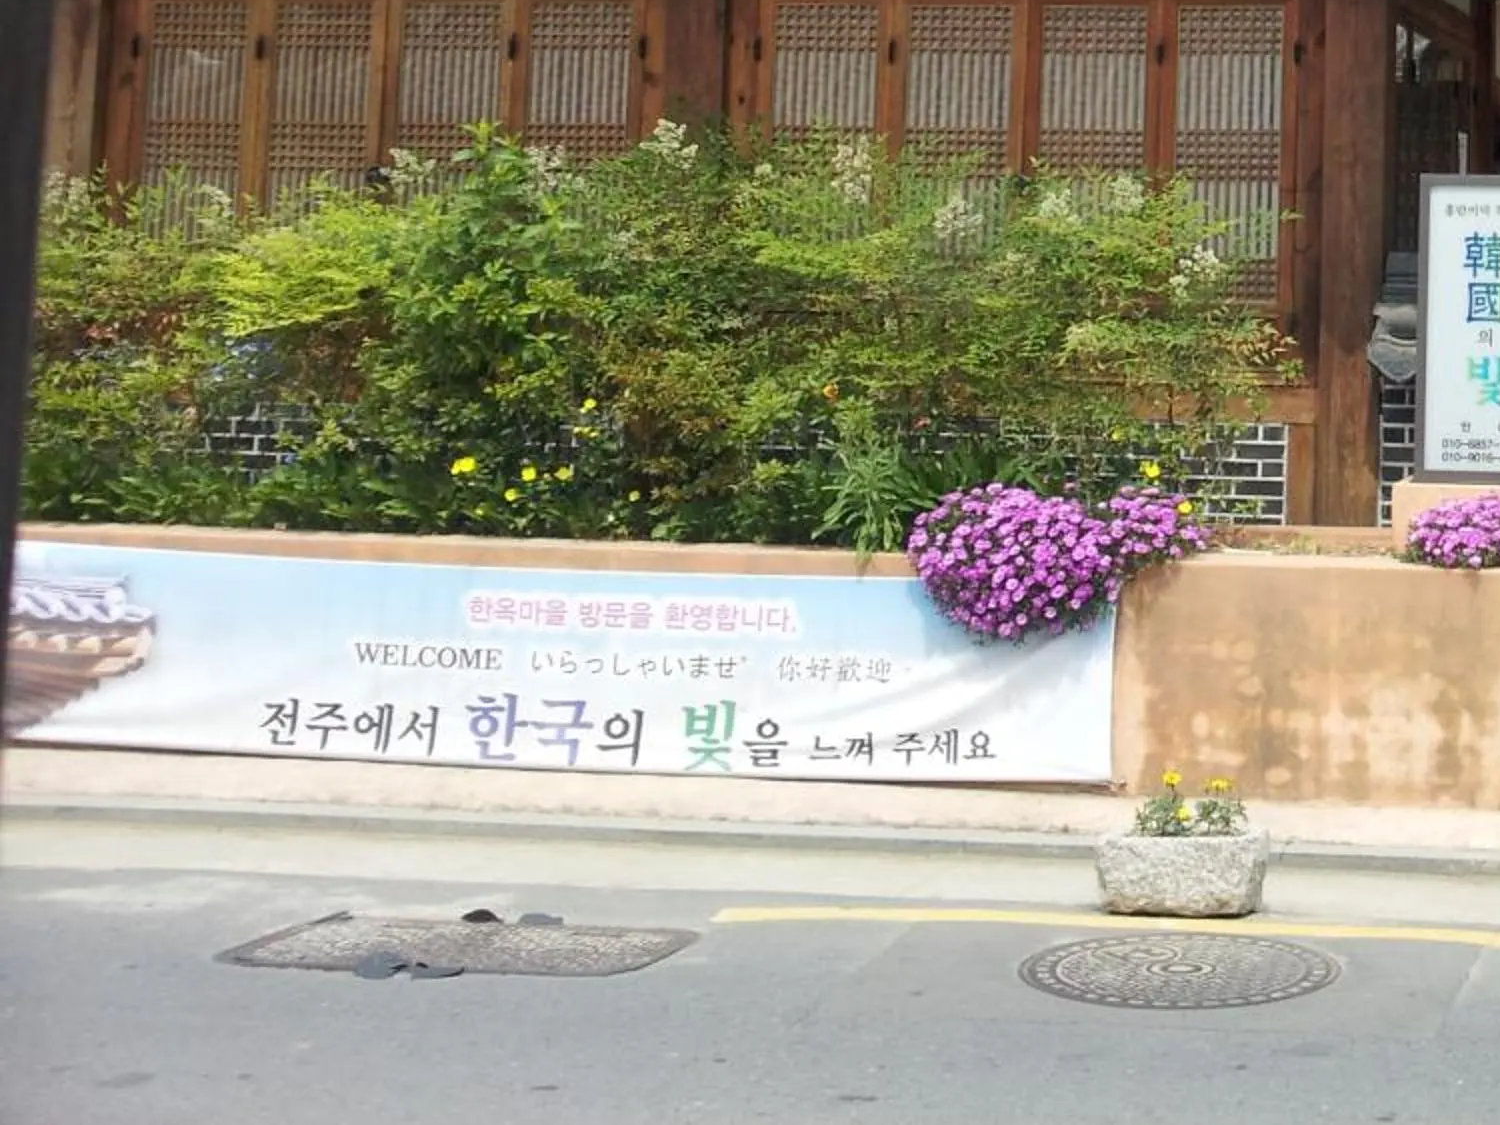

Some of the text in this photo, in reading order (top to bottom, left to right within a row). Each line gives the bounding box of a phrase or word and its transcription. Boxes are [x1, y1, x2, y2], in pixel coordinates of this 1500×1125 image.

[468, 595, 797, 633] 한옥마을 방문을 환영합니다.
[354, 642, 503, 671] WELCOME
[260, 692, 997, 772] 전주에서 한국의 빛을 느껴 주세요
